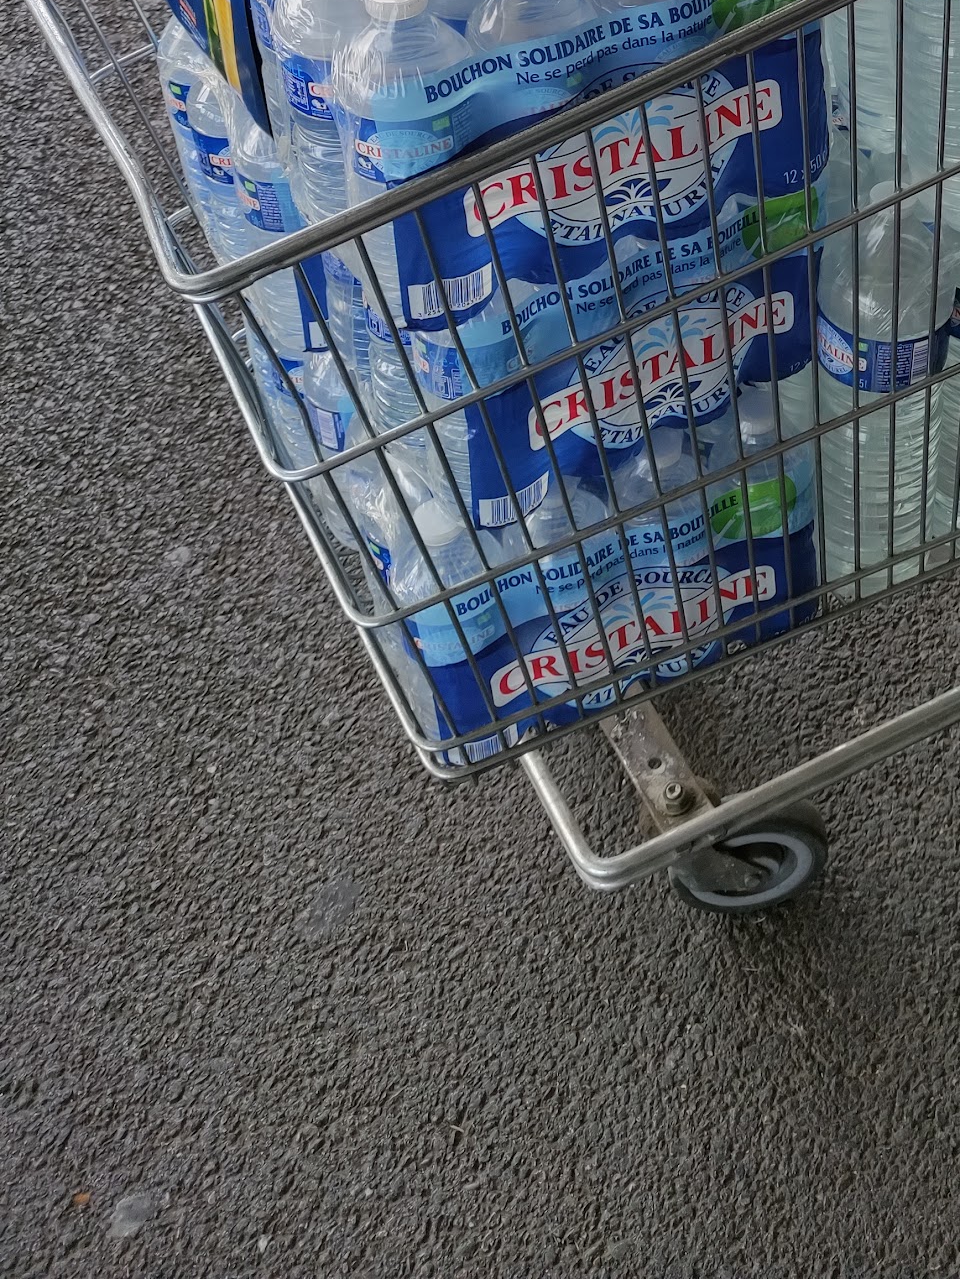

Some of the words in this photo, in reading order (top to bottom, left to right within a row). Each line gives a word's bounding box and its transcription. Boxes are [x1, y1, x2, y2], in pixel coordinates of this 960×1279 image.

[424, 53, 513, 104] BOUCHON
[519, 24, 606, 68] SOLIDAIRE
[609, 17, 634, 36] DE
[639, 11, 665, 30] SA
[515, 70, 540, 86] Ne
[543, 67, 562, 81] se
[565, 53, 594, 79] perd
[596, 44, 619, 67] pas
[621, 34, 658, 51] dans
[661, 30, 675, 44] la
[677, 14, 713, 39] nature
[357, 138, 452, 158] CRISTALINE
[472, 87, 773, 222] CRISTALINE
[783, 169, 797, 185] 12
[680, 240, 702, 258] SA
[707, 211, 763, 250] BOUTEILL
[576, 300, 597, 315] Ne
[599, 296, 614, 309] se
[642, 268, 663, 289] pas
[699, 255, 710, 267] la
[719, 237, 742, 258] ature
[534, 298, 786, 437] CRISTALINE
[558, 582, 574, 593] se
[605, 554, 626, 574] pas
[629, 546, 660, 560] dans
[676, 530, 706, 551] natur
[642, 531, 664, 545] SA
[498, 571, 768, 696] CRISTALINE
